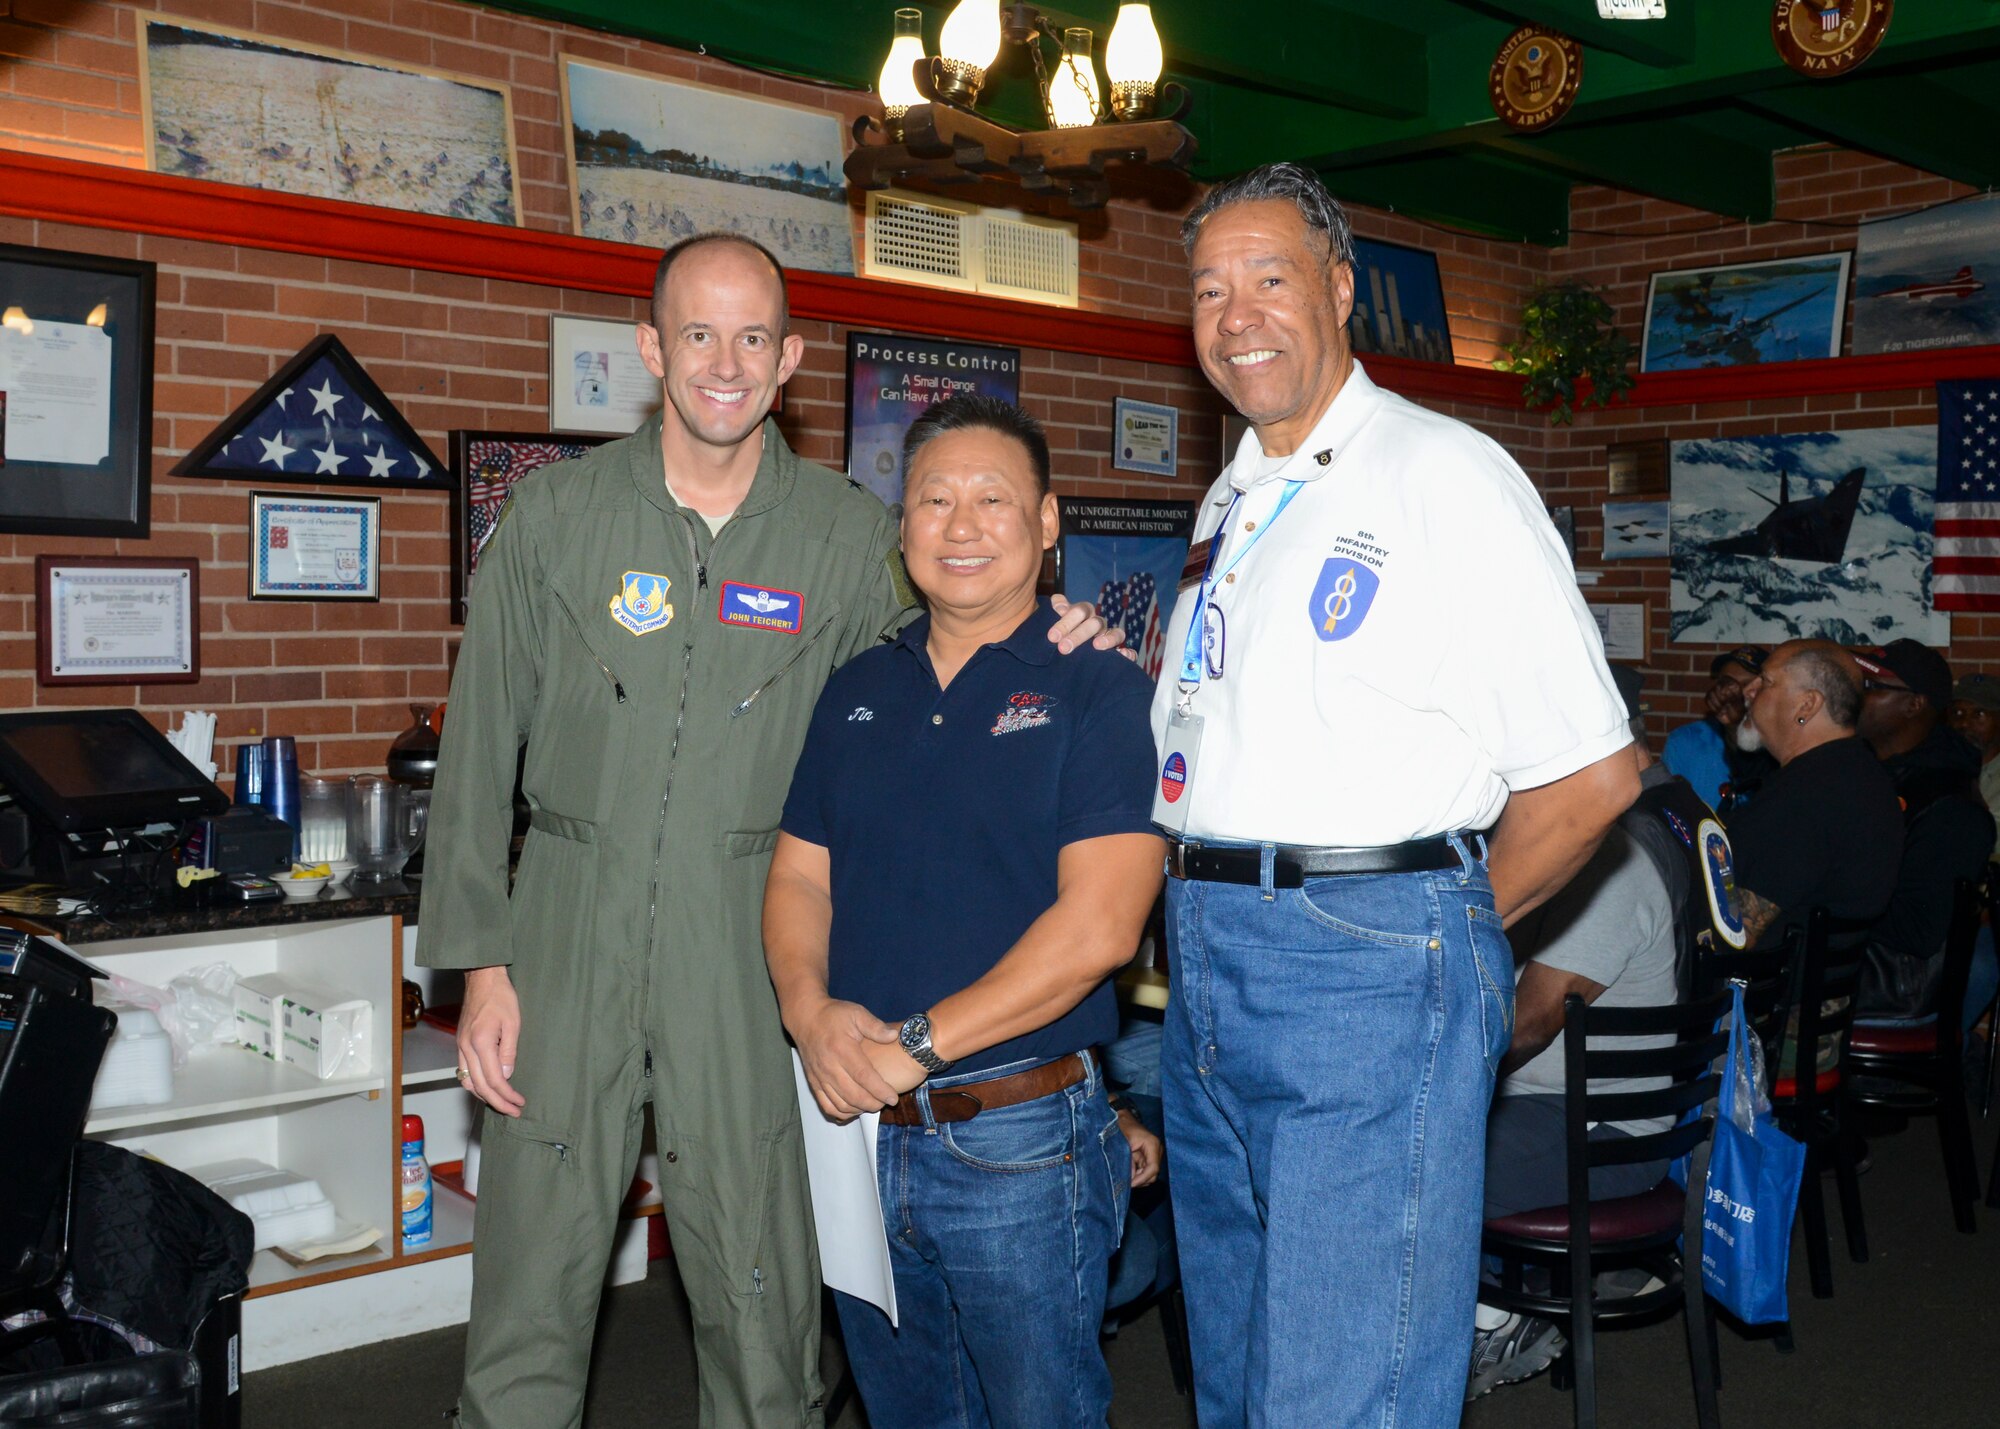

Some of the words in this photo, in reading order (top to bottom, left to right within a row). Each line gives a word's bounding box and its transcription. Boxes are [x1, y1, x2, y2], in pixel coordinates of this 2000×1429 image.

[1498, 27, 1533, 65] UNITED
[1803, 47, 1855, 69] NAVY
[1517, 106, 1554, 125] ARMY
[1883, 342, 1902, 352] F-20
[1906, 334, 1970, 349] TIGERSHARK
[856, 342, 939, 365] Process
[946, 352, 1016, 373] Control
[901, 374, 911, 386] A
[914, 374, 939, 388] Small
[941, 377, 976, 392] Change
[881, 387, 900, 401] Can
[903, 389, 929, 403] Have
[931, 392, 940, 403] A
[1134, 420, 1148, 429] LEAD
[1320, 454, 1328, 465] 8
[1065, 505, 1078, 515] AN
[1080, 506, 1150, 518] UNFORGETTABLE
[1151, 509, 1188, 519] MOMENT
[1080, 520, 1091, 529] IN
[1092, 520, 1138, 531] AMERICAN
[1139, 521, 1175, 532] HISTORY
[1357, 530, 1375, 541] 8th
[1335, 536, 1390, 558] INFANTRY
[1333, 545, 1384, 568] DIVISION
[643, 613, 669, 630] COMMAND
[728, 612, 750, 622] JOHN
[752, 616, 793, 629] TEICHERT
[1167, 770, 1184, 782] VOTED
